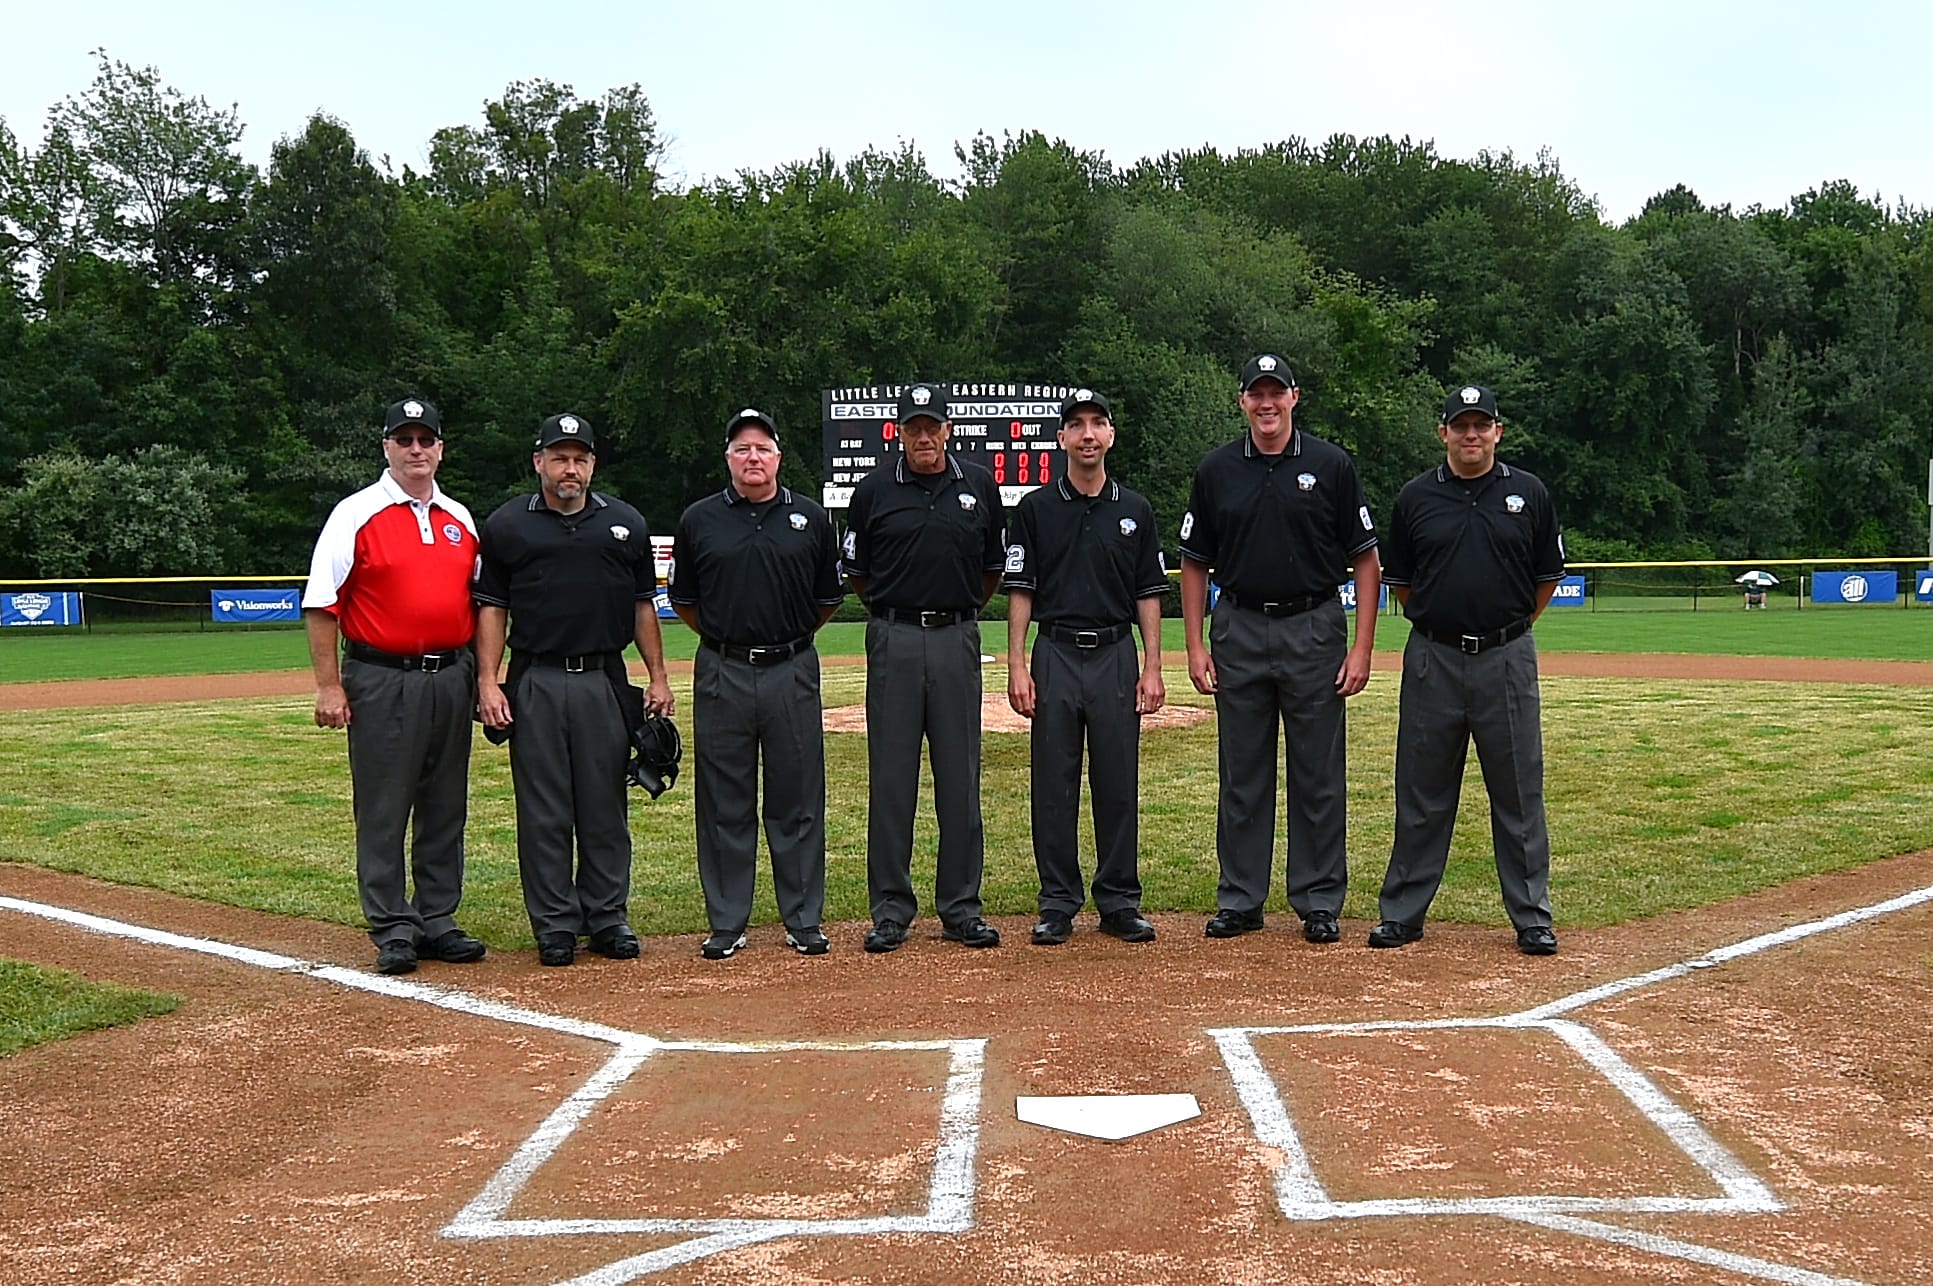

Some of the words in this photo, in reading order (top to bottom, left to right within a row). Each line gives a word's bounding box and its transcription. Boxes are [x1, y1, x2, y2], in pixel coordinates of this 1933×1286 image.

[831, 387, 879, 401] LITTLE
[952, 384, 1016, 396] EASTERN
[834, 406, 897, 417] EASTO
[948, 405, 1062, 416] UNDATION
[882, 421, 895, 440] 0
[953, 424, 987, 436] STRIKE
[1010, 421, 1021, 438] 0
[1022, 424, 1041, 436] OUT
[970, 442, 976, 451] 7
[832, 458, 852, 467] NEW
[853, 457, 876, 466] YORK
[995, 452, 1005, 468] 0
[1019, 452, 1029, 468] 0
[995, 469, 1005, 484] 0
[1019, 468, 1029, 484] 0
[1040, 468, 1050, 484] 0
[1181, 511, 1194, 540] 8
[843, 531, 857, 560] 4
[1005, 544, 1025, 573] 2
[1842, 578, 1865, 598] all
[236, 599, 293, 610] Visionworks
